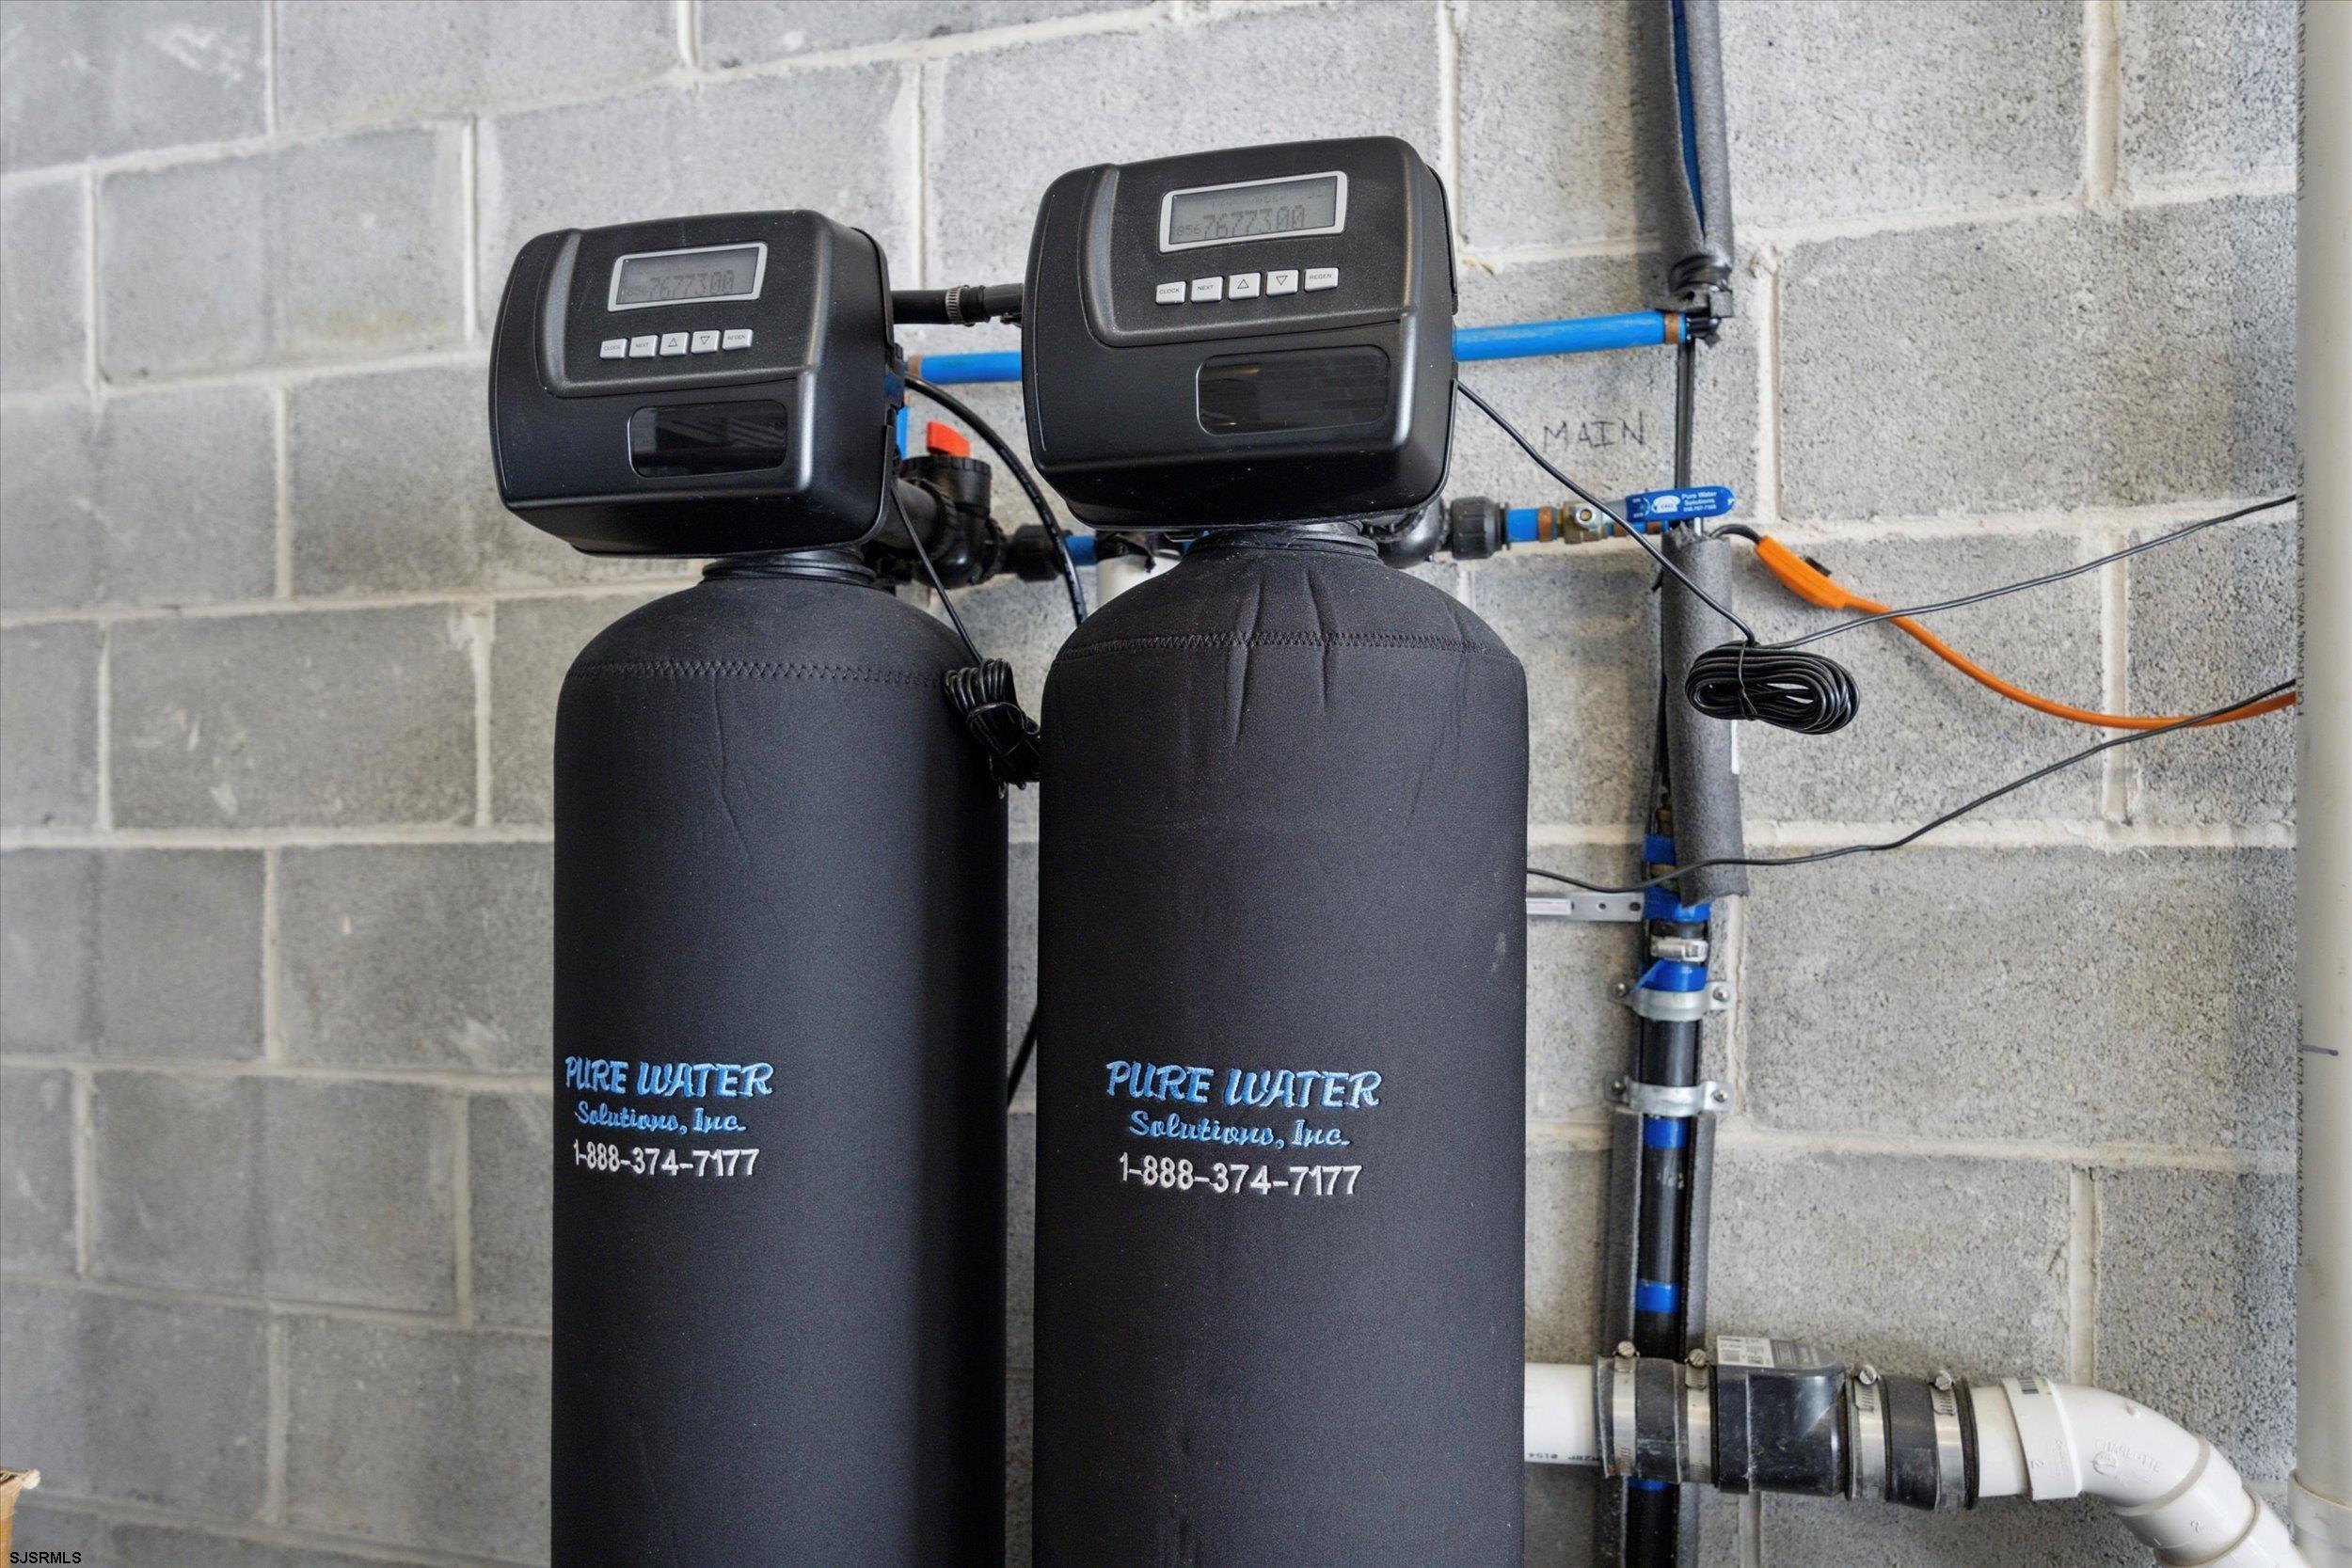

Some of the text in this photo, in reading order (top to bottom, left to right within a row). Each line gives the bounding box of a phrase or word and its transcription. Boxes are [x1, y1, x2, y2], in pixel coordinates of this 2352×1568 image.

[1542, 411, 1645, 454] MAIN
[564, 1055, 774, 1098] PURE WATER
[1105, 1060, 1382, 1108] PURE WATER
[576, 1101, 747, 1134] Solutions, Inc.
[1129, 1110, 1351, 1148] Solutions, Inc.
[573, 1138, 760, 1177] 1-888-374-7177
[1119, 1151, 1363, 1196] 1-888-374-7177
